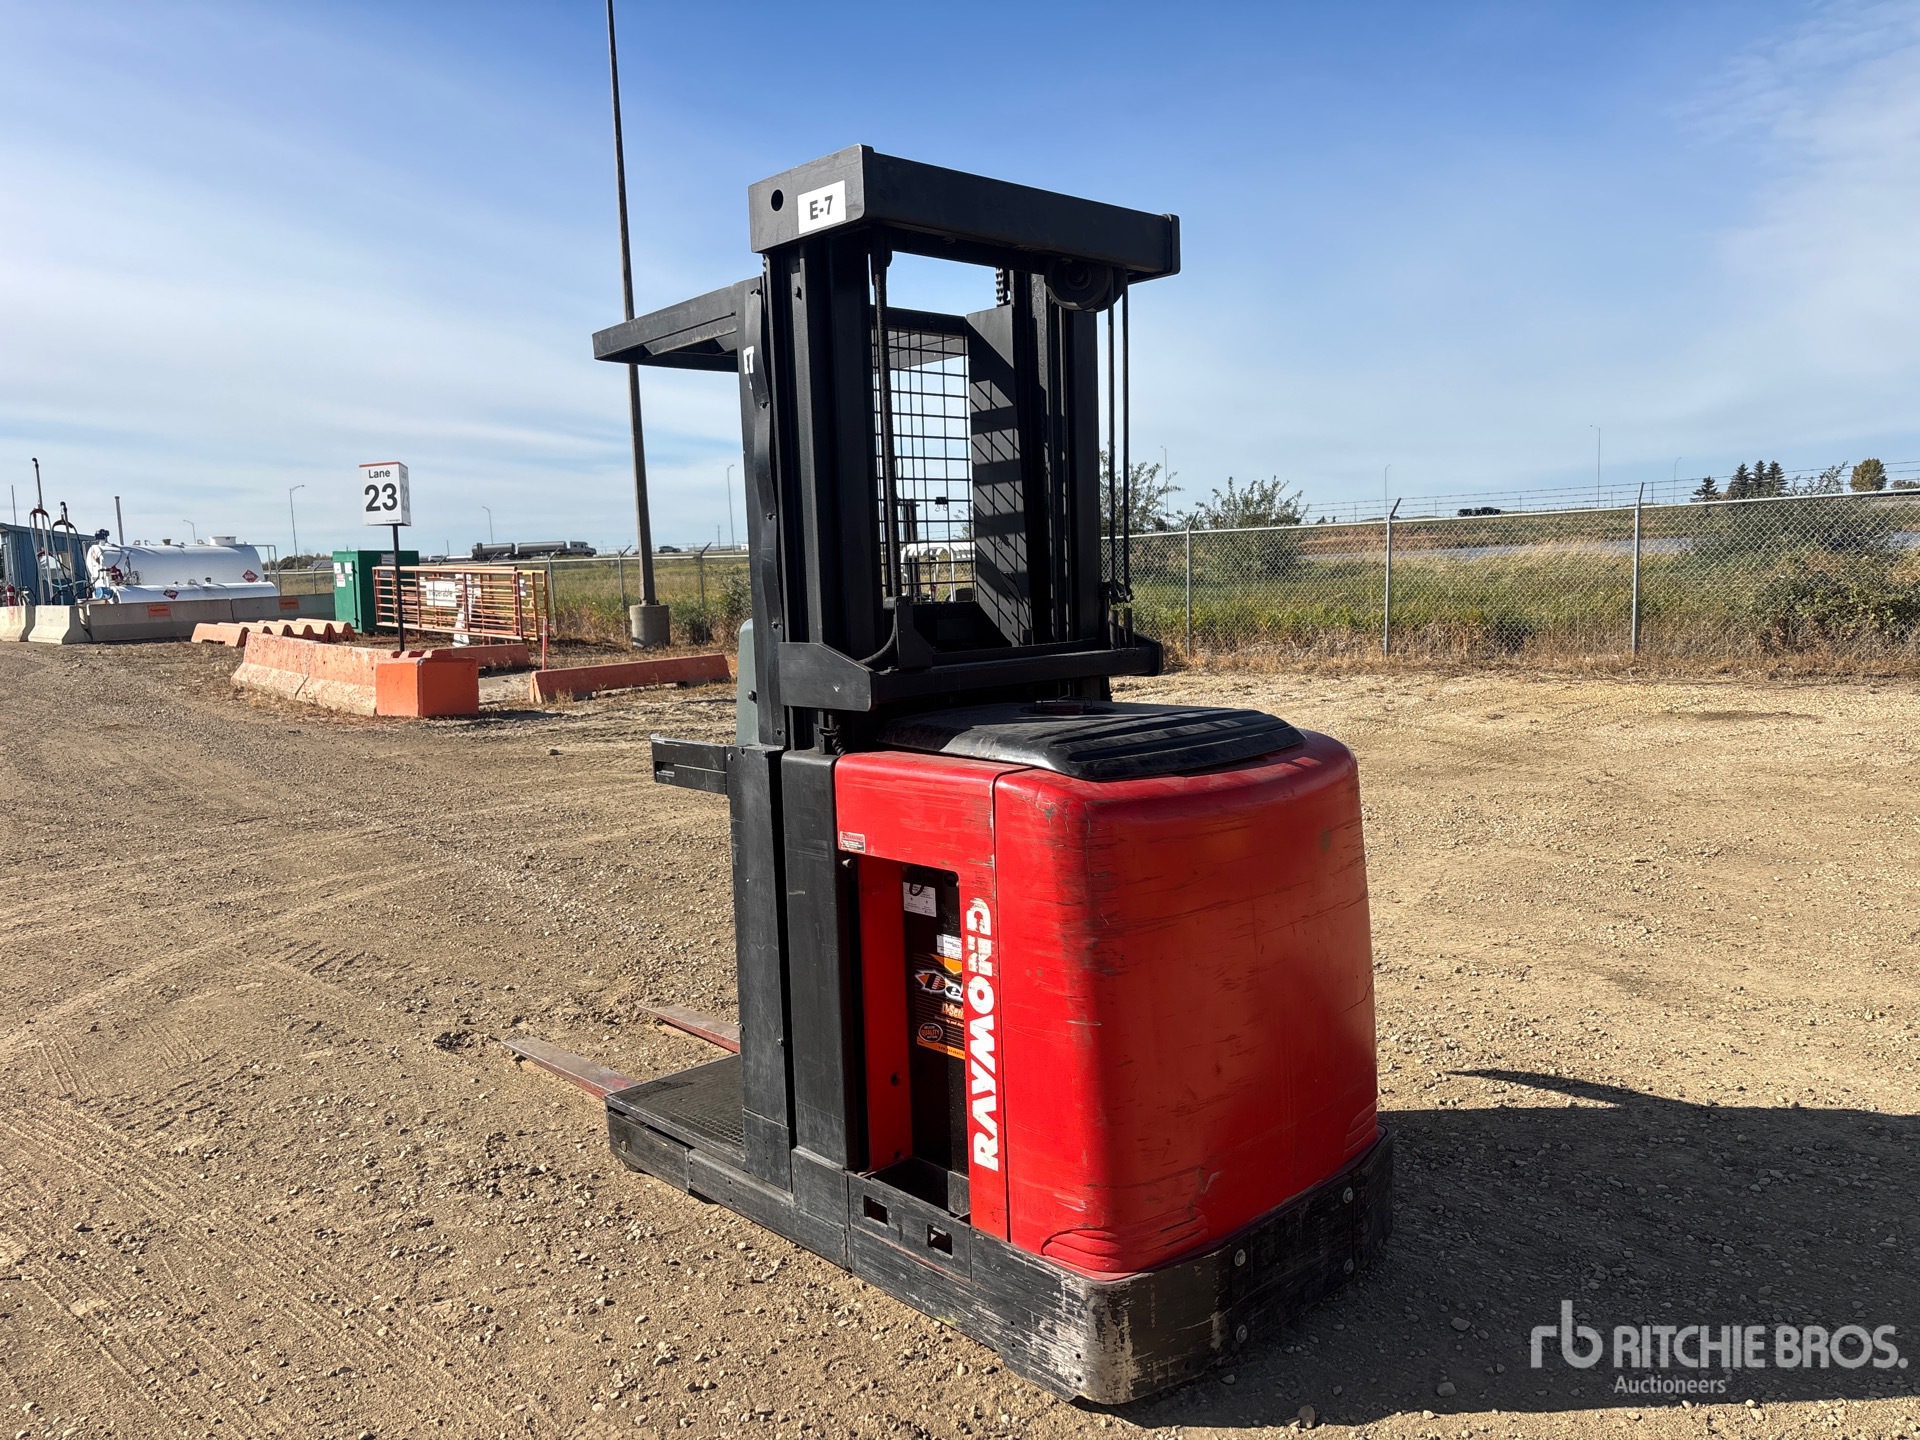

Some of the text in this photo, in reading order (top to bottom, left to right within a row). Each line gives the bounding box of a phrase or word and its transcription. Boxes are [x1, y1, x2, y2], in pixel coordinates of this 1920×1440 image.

[809, 195, 833, 220] E-7
[368, 469, 391, 479] Lane
[364, 483, 398, 512] 23
[966, 897, 999, 1172] RAYMOND
